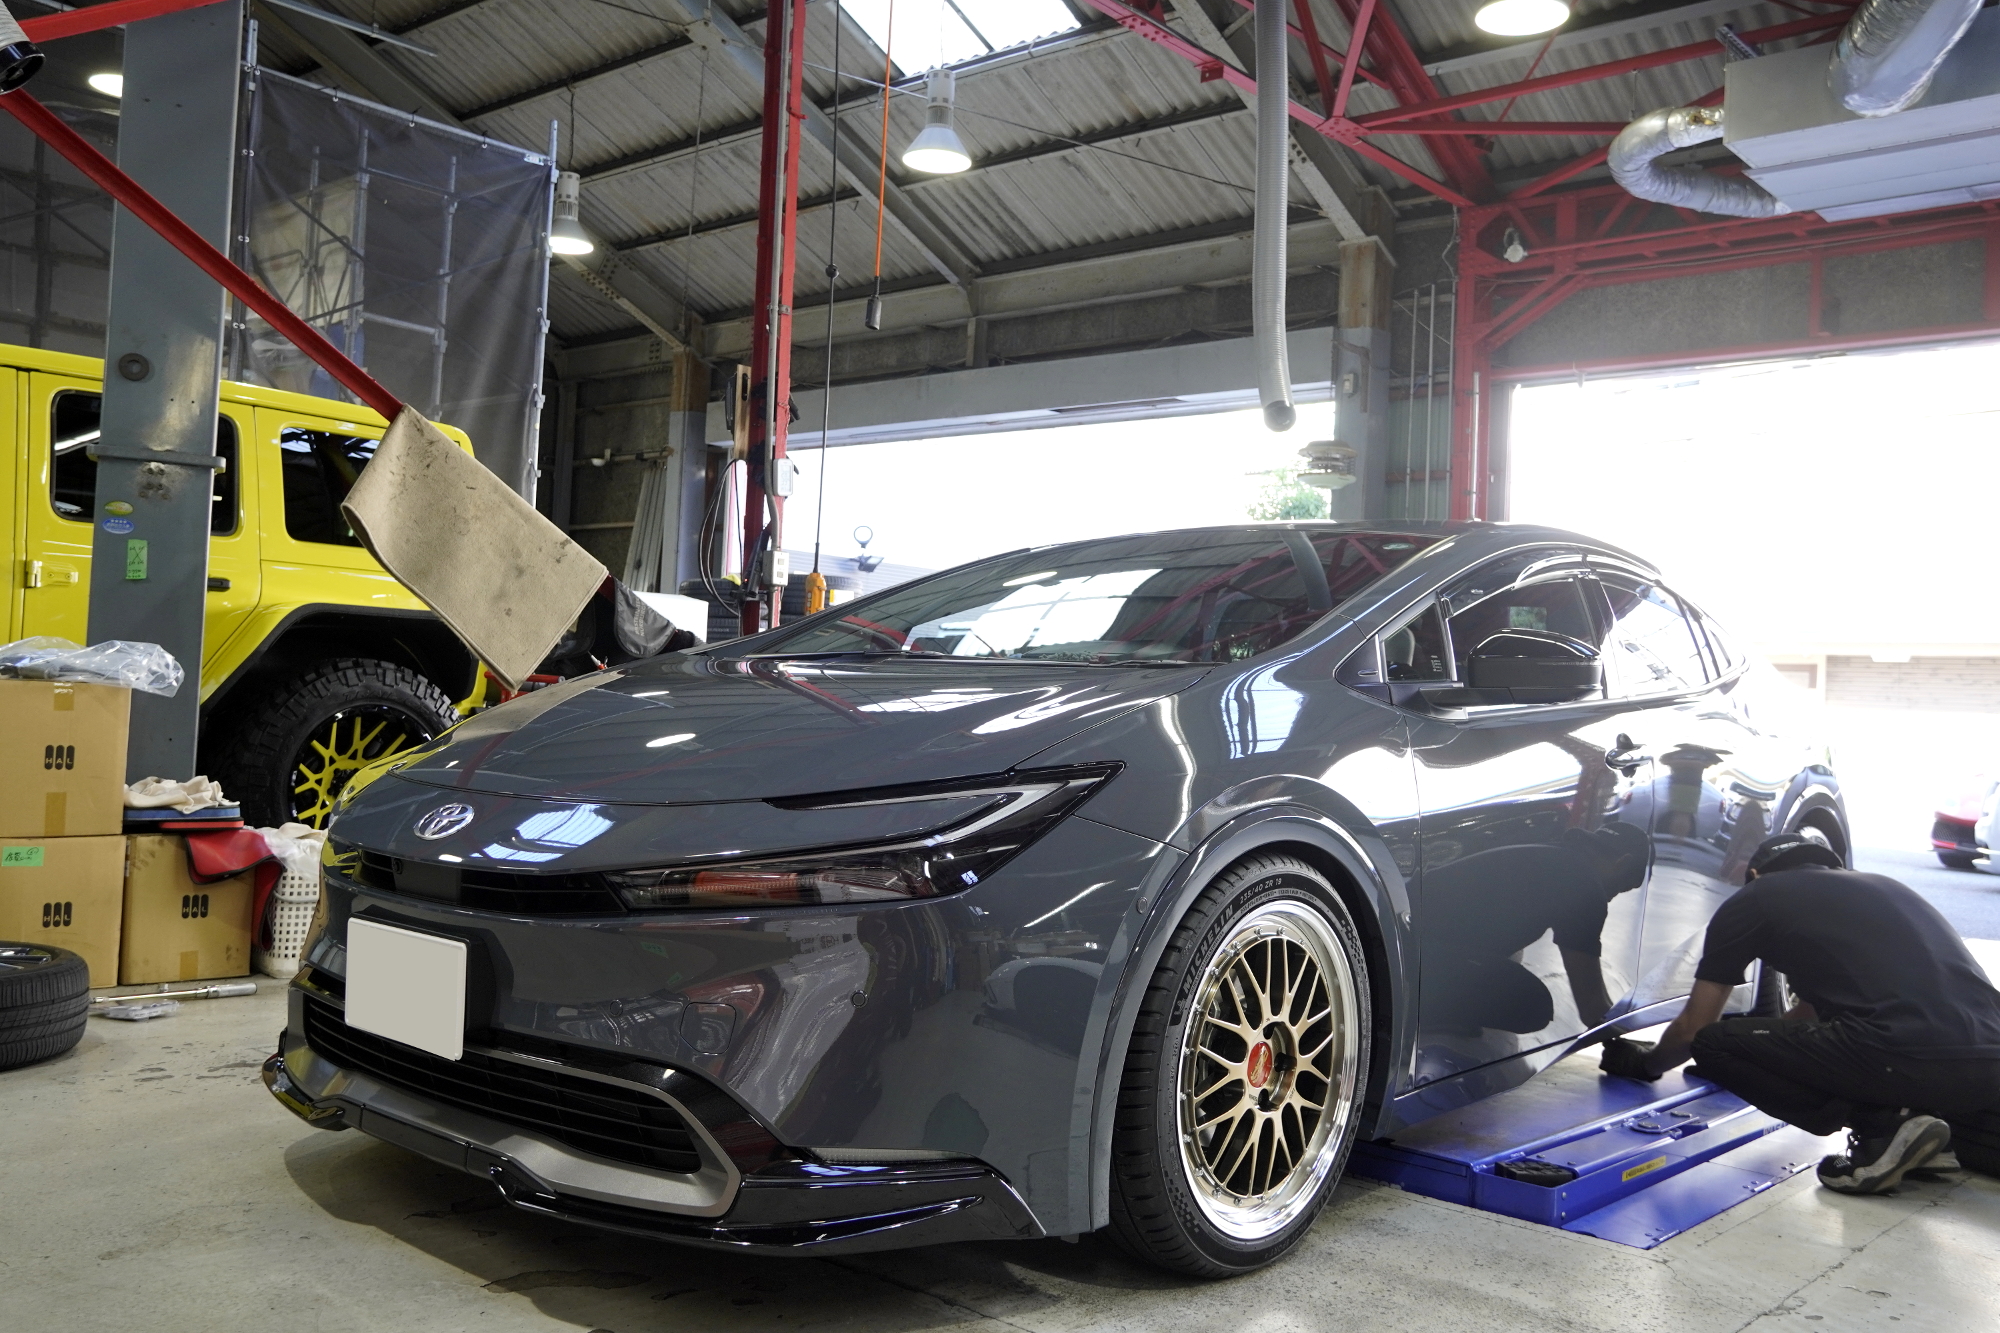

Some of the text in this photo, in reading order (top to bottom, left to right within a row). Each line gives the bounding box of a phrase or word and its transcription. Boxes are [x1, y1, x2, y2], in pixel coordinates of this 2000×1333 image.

[1240, 883, 1264, 905] 235/40
[1264, 879, 1274, 889] ZR
[1182, 904, 1234, 993] MICHELIN
